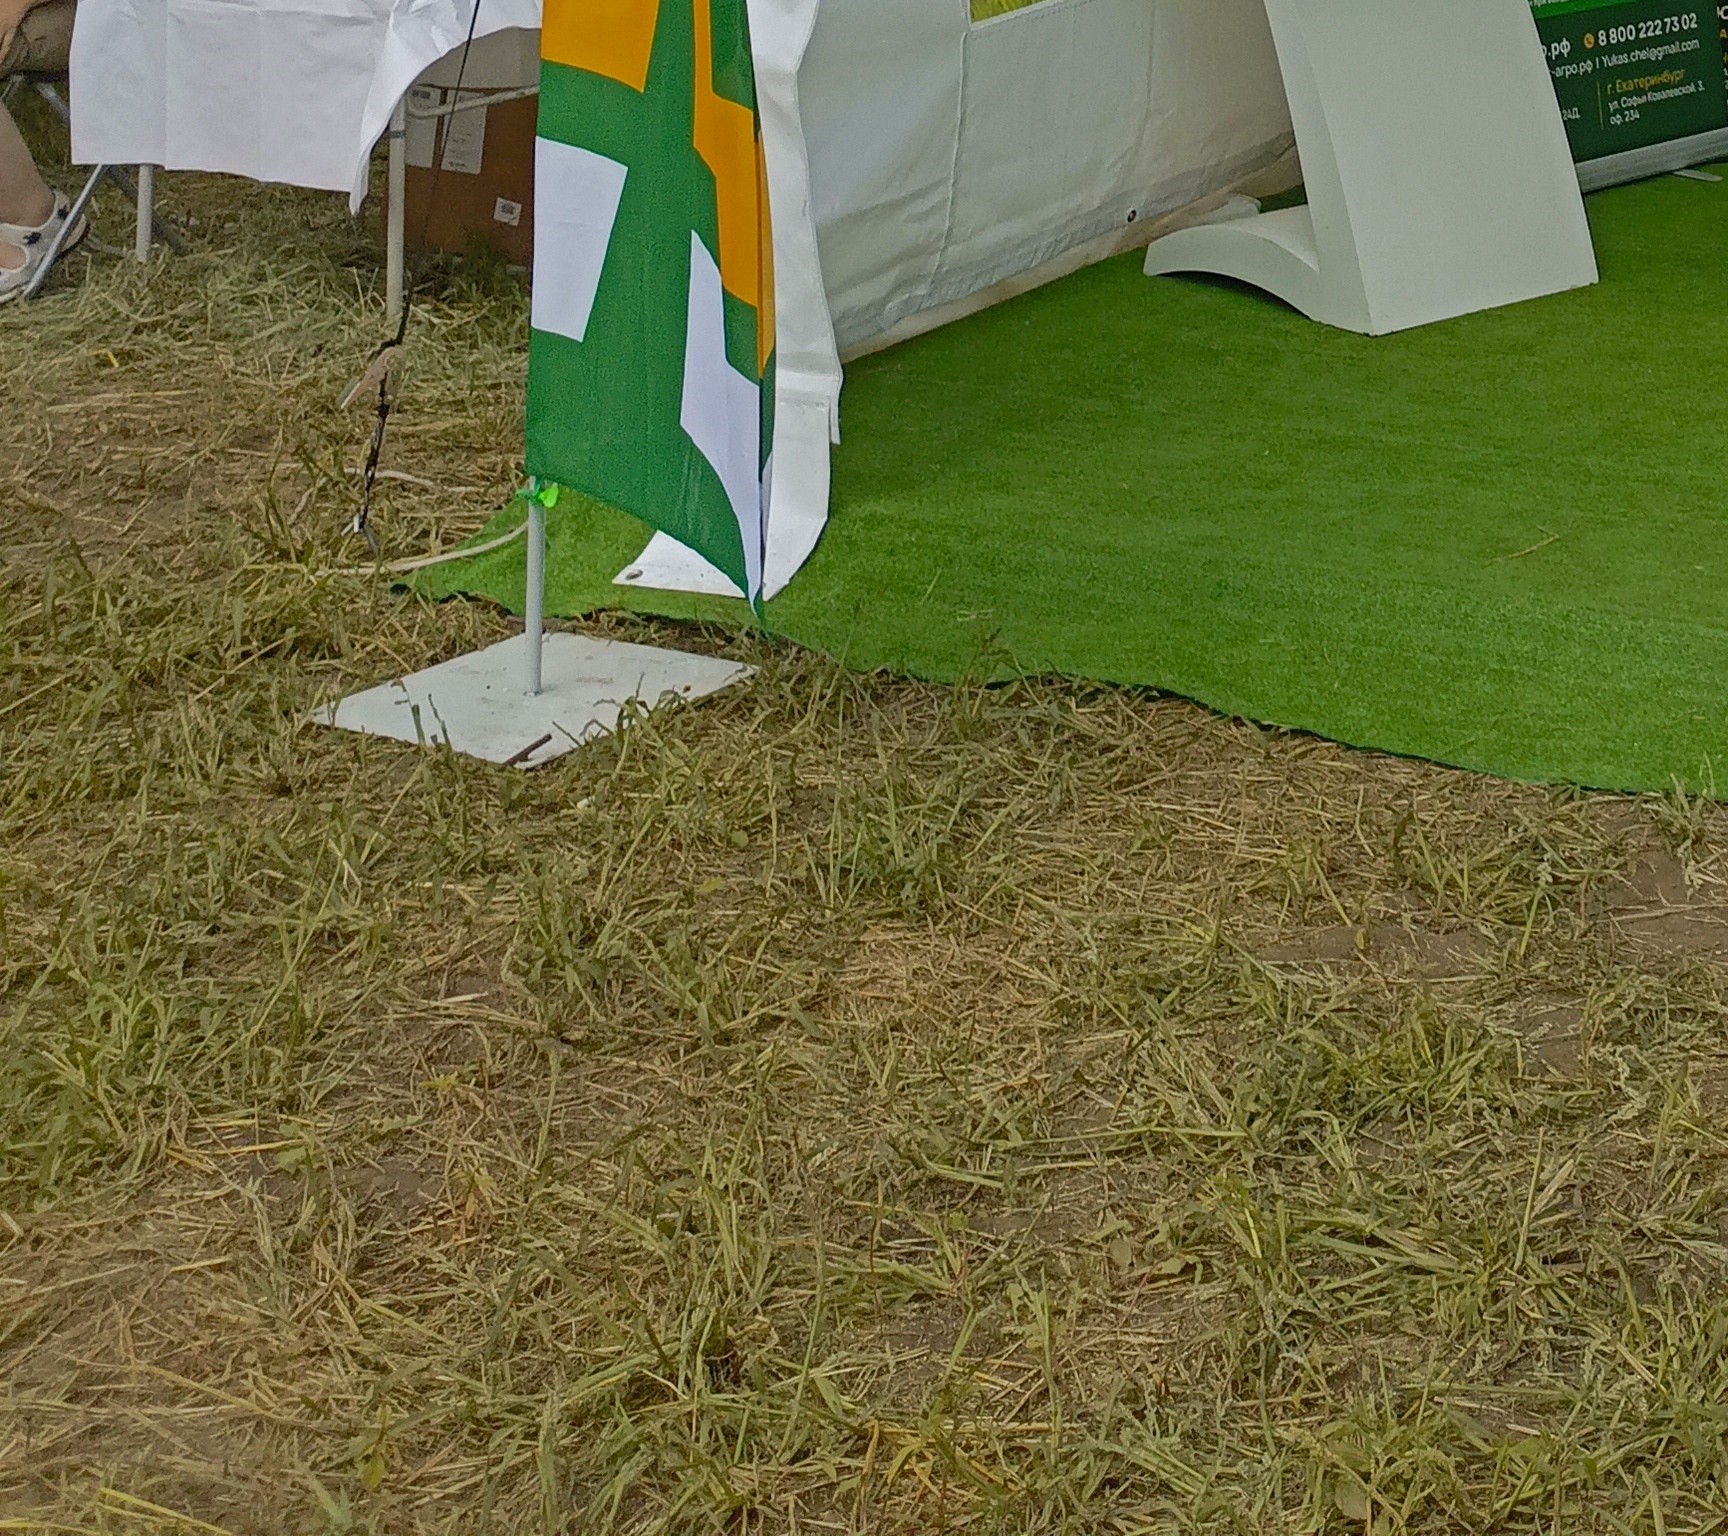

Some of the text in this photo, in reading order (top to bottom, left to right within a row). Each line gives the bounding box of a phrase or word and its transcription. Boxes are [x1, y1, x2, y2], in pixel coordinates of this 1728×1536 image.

[1598, 13, 1697, 46] 8 800 222 73 02
[1616, 69, 1685, 93] Екатеринбург
[1624, 110, 1640, 121] 234
